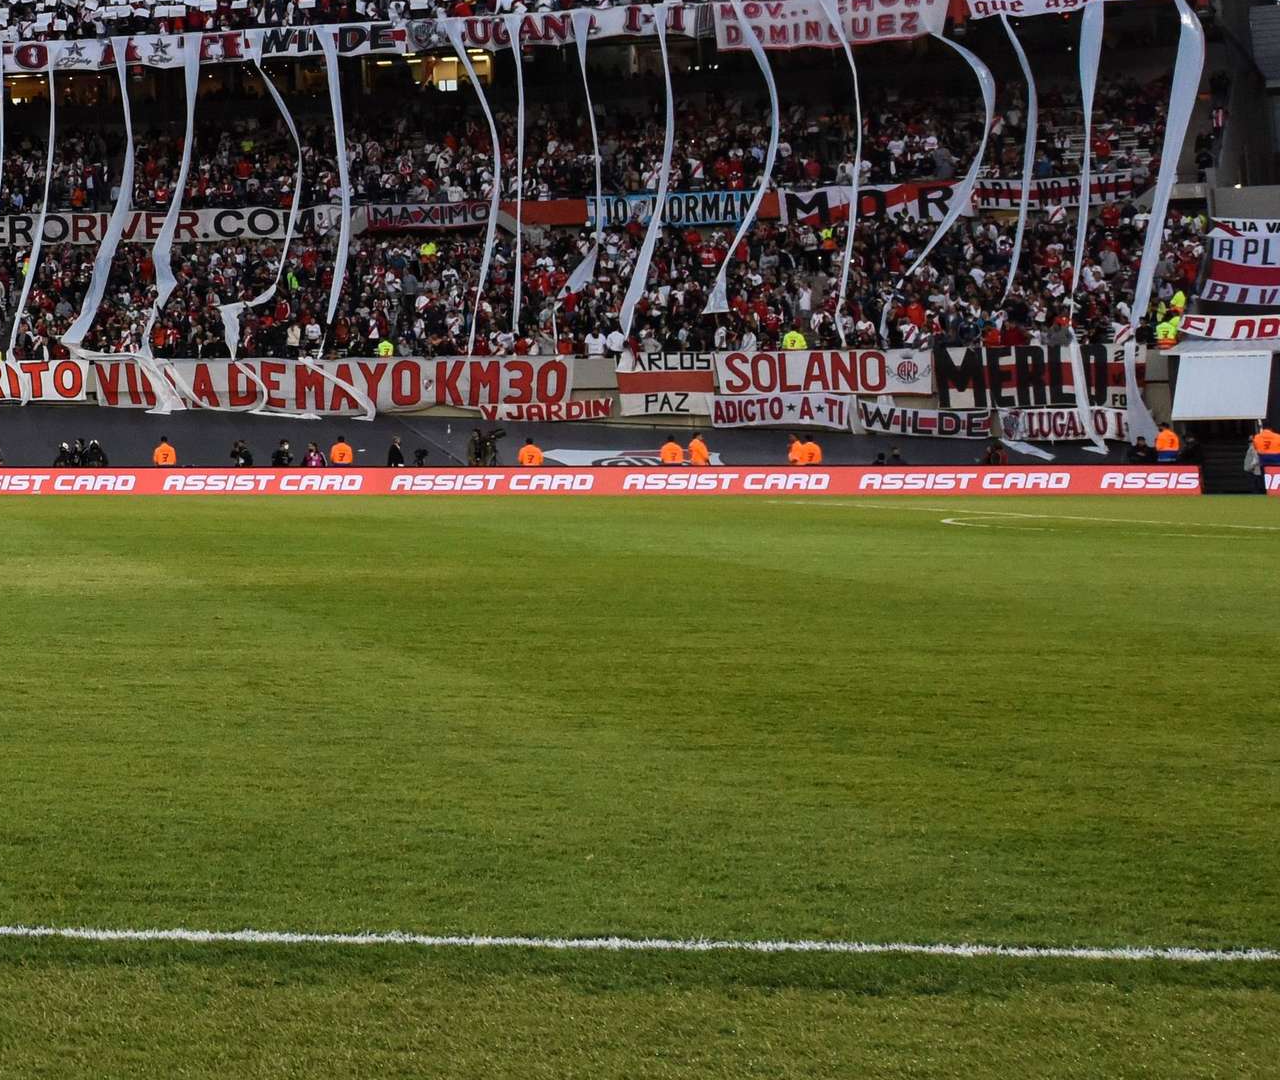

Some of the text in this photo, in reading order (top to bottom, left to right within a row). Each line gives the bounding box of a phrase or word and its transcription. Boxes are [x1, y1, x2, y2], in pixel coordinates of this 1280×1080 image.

[372, 205, 489, 224] MAXIMO
[725, 351, 887, 394] SOLANO
[935, 344, 1109, 409] MERLO
[295, 360, 422, 411] MAYO
[644, 393, 689, 413] PAZ
[713, 397, 783, 423] ADICTO
[861, 406, 988, 437] WILDE
[54, 475, 136, 489] CARD
[163, 475, 364, 490] ASSIST CARD
[390, 474, 594, 489] ASSIST CARD
[622, 474, 830, 489] ASSIST CARD
[859, 473, 1070, 489] ASSIST CARD
[1100, 473, 1200, 489] ASSIS
